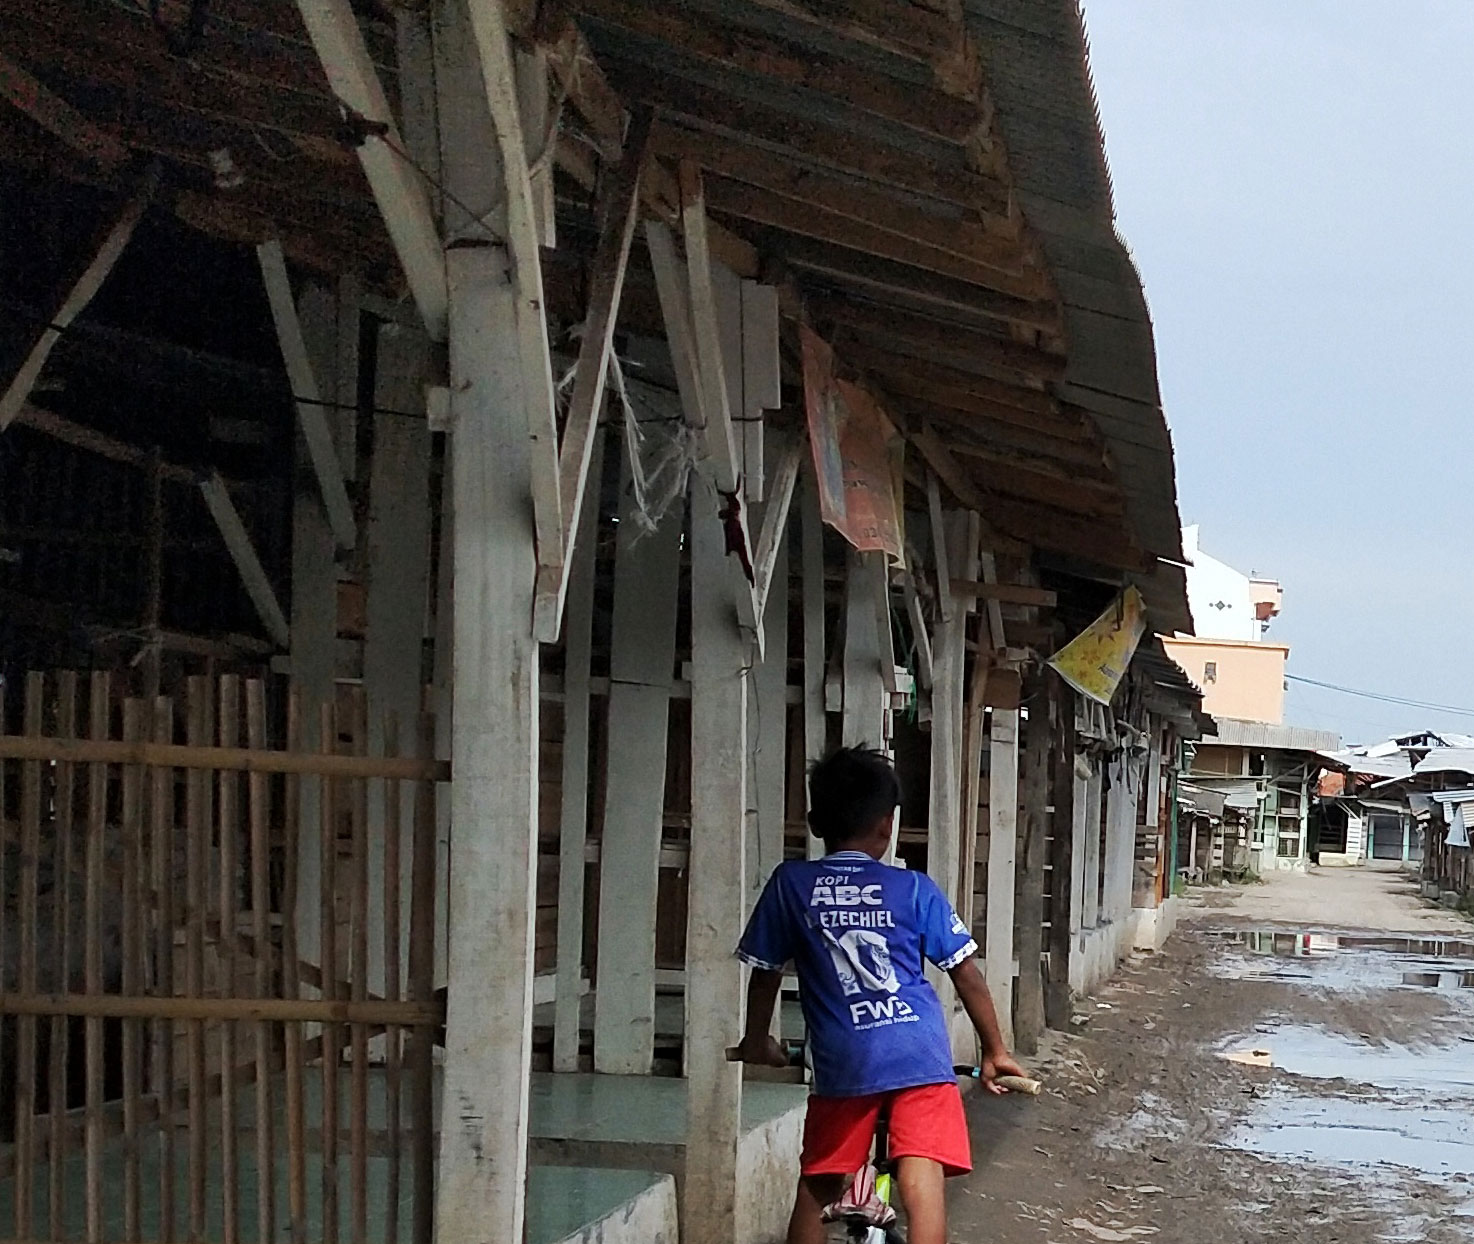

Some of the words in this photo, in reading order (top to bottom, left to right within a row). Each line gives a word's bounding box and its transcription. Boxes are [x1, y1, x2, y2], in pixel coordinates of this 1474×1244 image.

[815, 875, 849, 886] KOPI
[810, 884, 883, 907] ABC
[820, 910, 896, 928] EZECHIEL
[822, 930, 902, 996] 10
